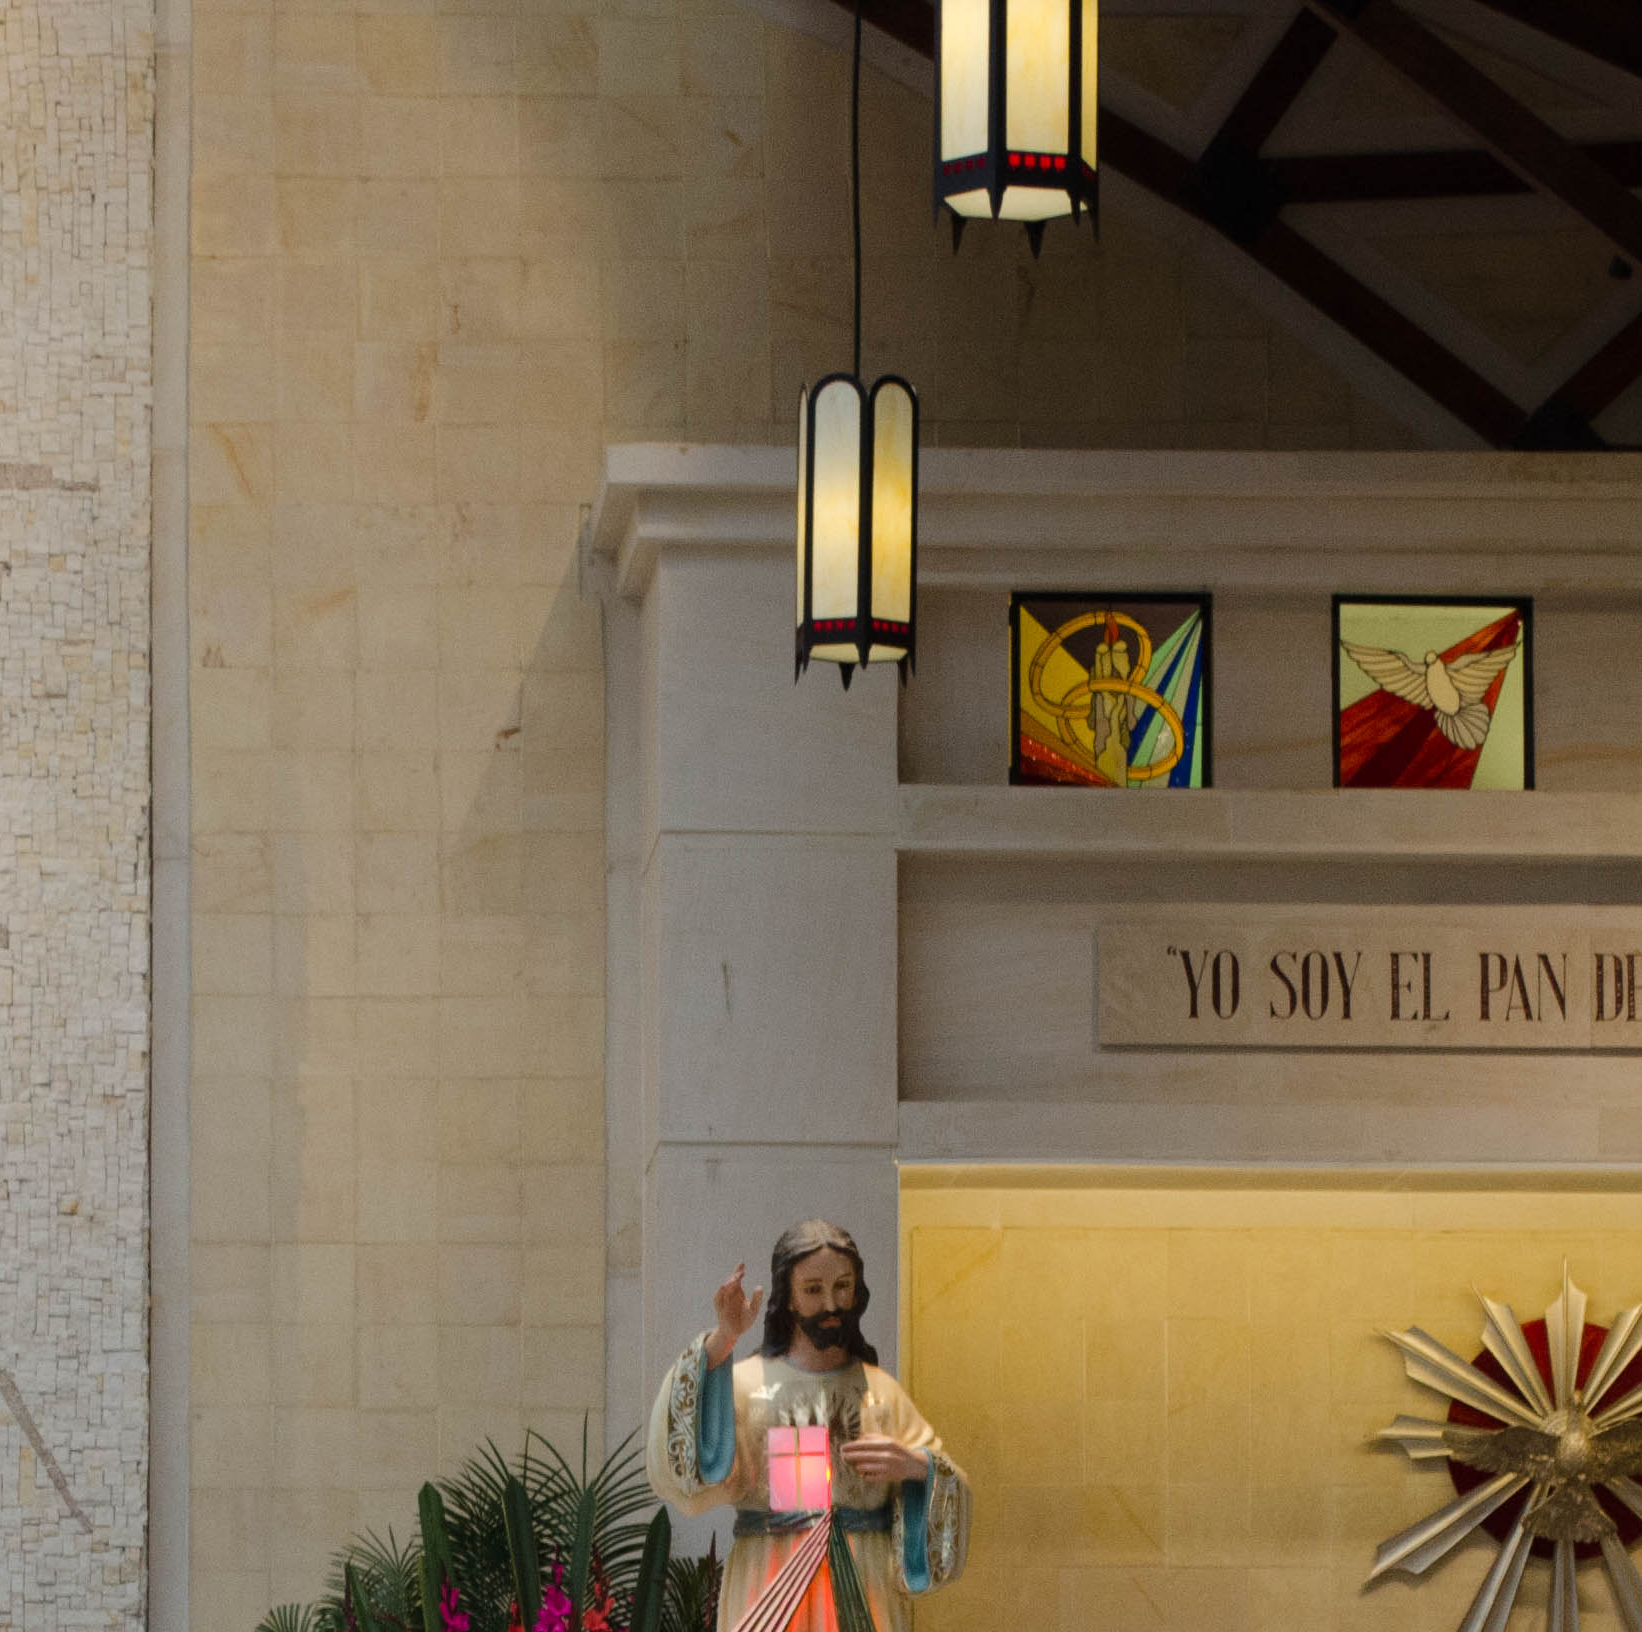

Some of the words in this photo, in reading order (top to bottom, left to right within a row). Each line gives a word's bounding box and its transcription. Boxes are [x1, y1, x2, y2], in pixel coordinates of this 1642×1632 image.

[1269, 949, 1361, 1021] SOY
[1389, 951, 1450, 1022] EL
[1479, 951, 1567, 1022] PAN
